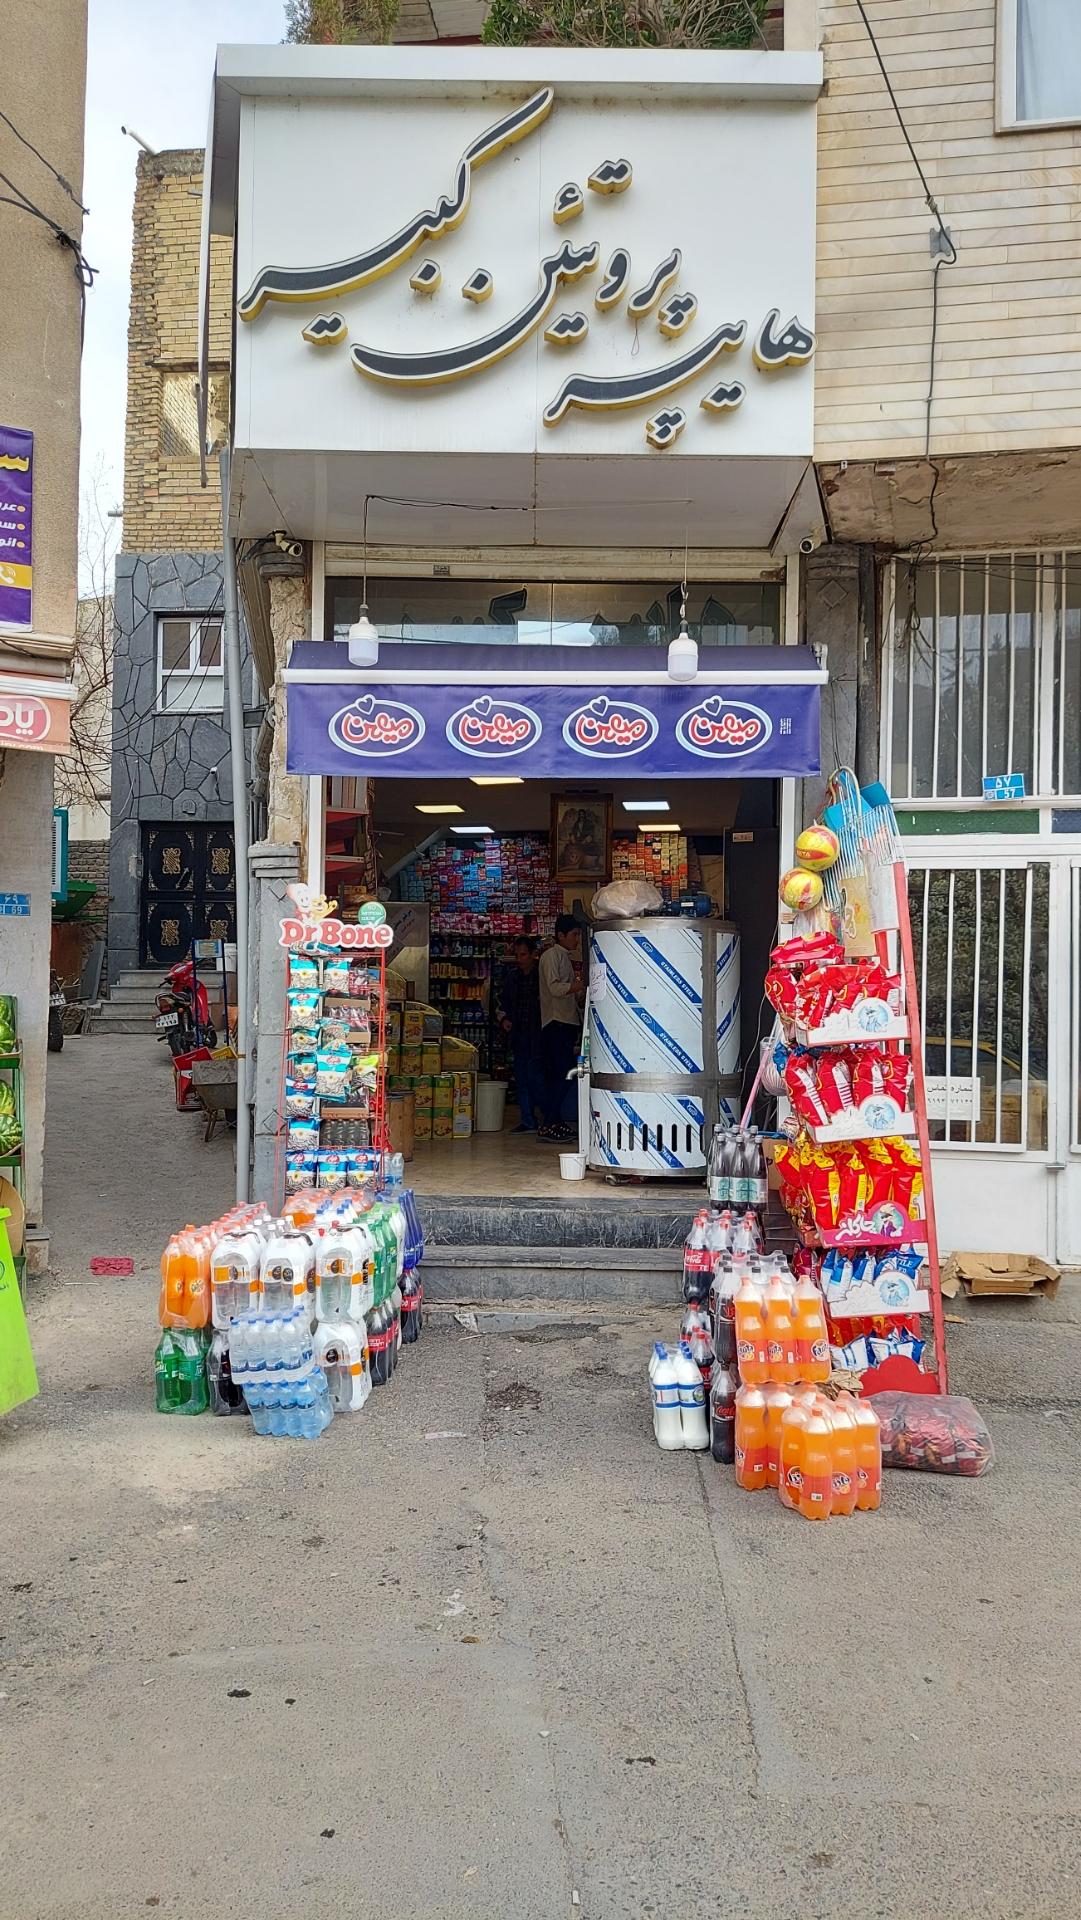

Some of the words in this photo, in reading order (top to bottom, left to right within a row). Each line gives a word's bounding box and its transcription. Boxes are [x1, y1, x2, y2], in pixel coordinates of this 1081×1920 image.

[236, 84, 555, 346] کبیر
[350, 157, 698, 388] پروتئین
[543, 308, 818, 449] هایپر
[342, 712, 414, 744] میهن
[459, 713, 531, 744] میهن
[575, 713, 648, 745] میهن
[688, 713, 761, 745] میهن
[995, 776, 1011, 789] ۵۷
[1004, 789, 1016, 799] 57
[282, 920, 318, 945] Dr
[320, 920, 391, 945] Bone
[660, 961, 684, 985] STAINLESS
[681, 981, 695, 998] STEEL
[659, 1032, 682, 1057] STAINLESS
[680, 1054, 694, 1070] STEEL
